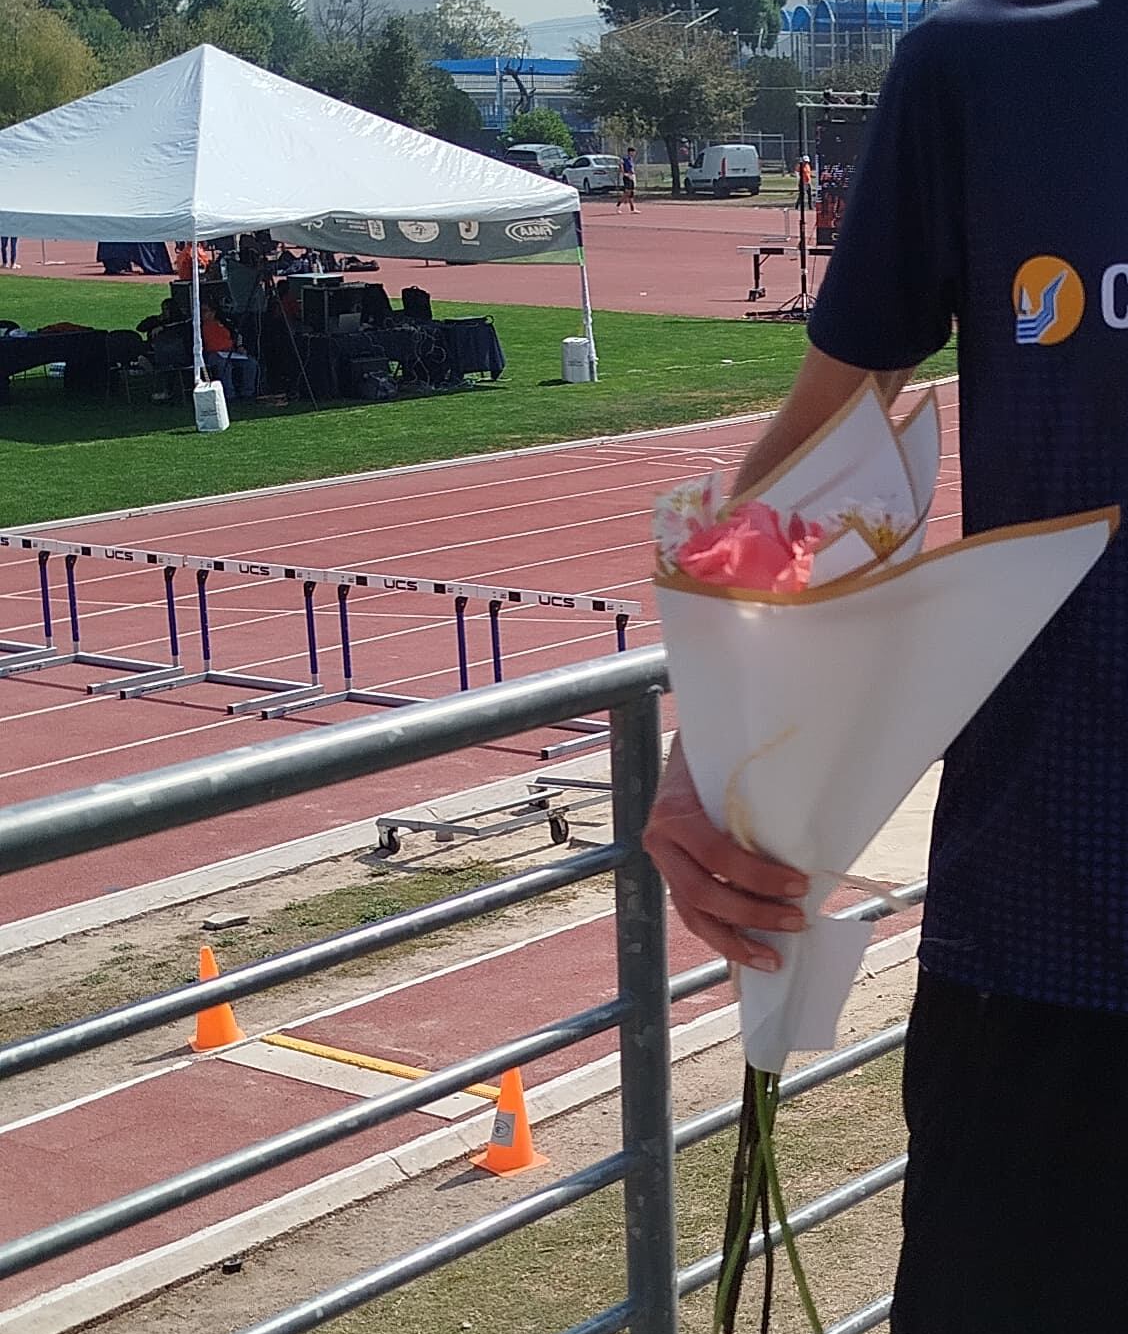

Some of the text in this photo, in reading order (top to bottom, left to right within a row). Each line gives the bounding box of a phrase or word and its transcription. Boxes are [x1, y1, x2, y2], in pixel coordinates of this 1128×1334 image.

[105, 549, 134, 561] UCS
[239, 563, 270, 576] UCS
[383, 578, 418, 591] UCS
[537, 594, 576, 608] UCS
